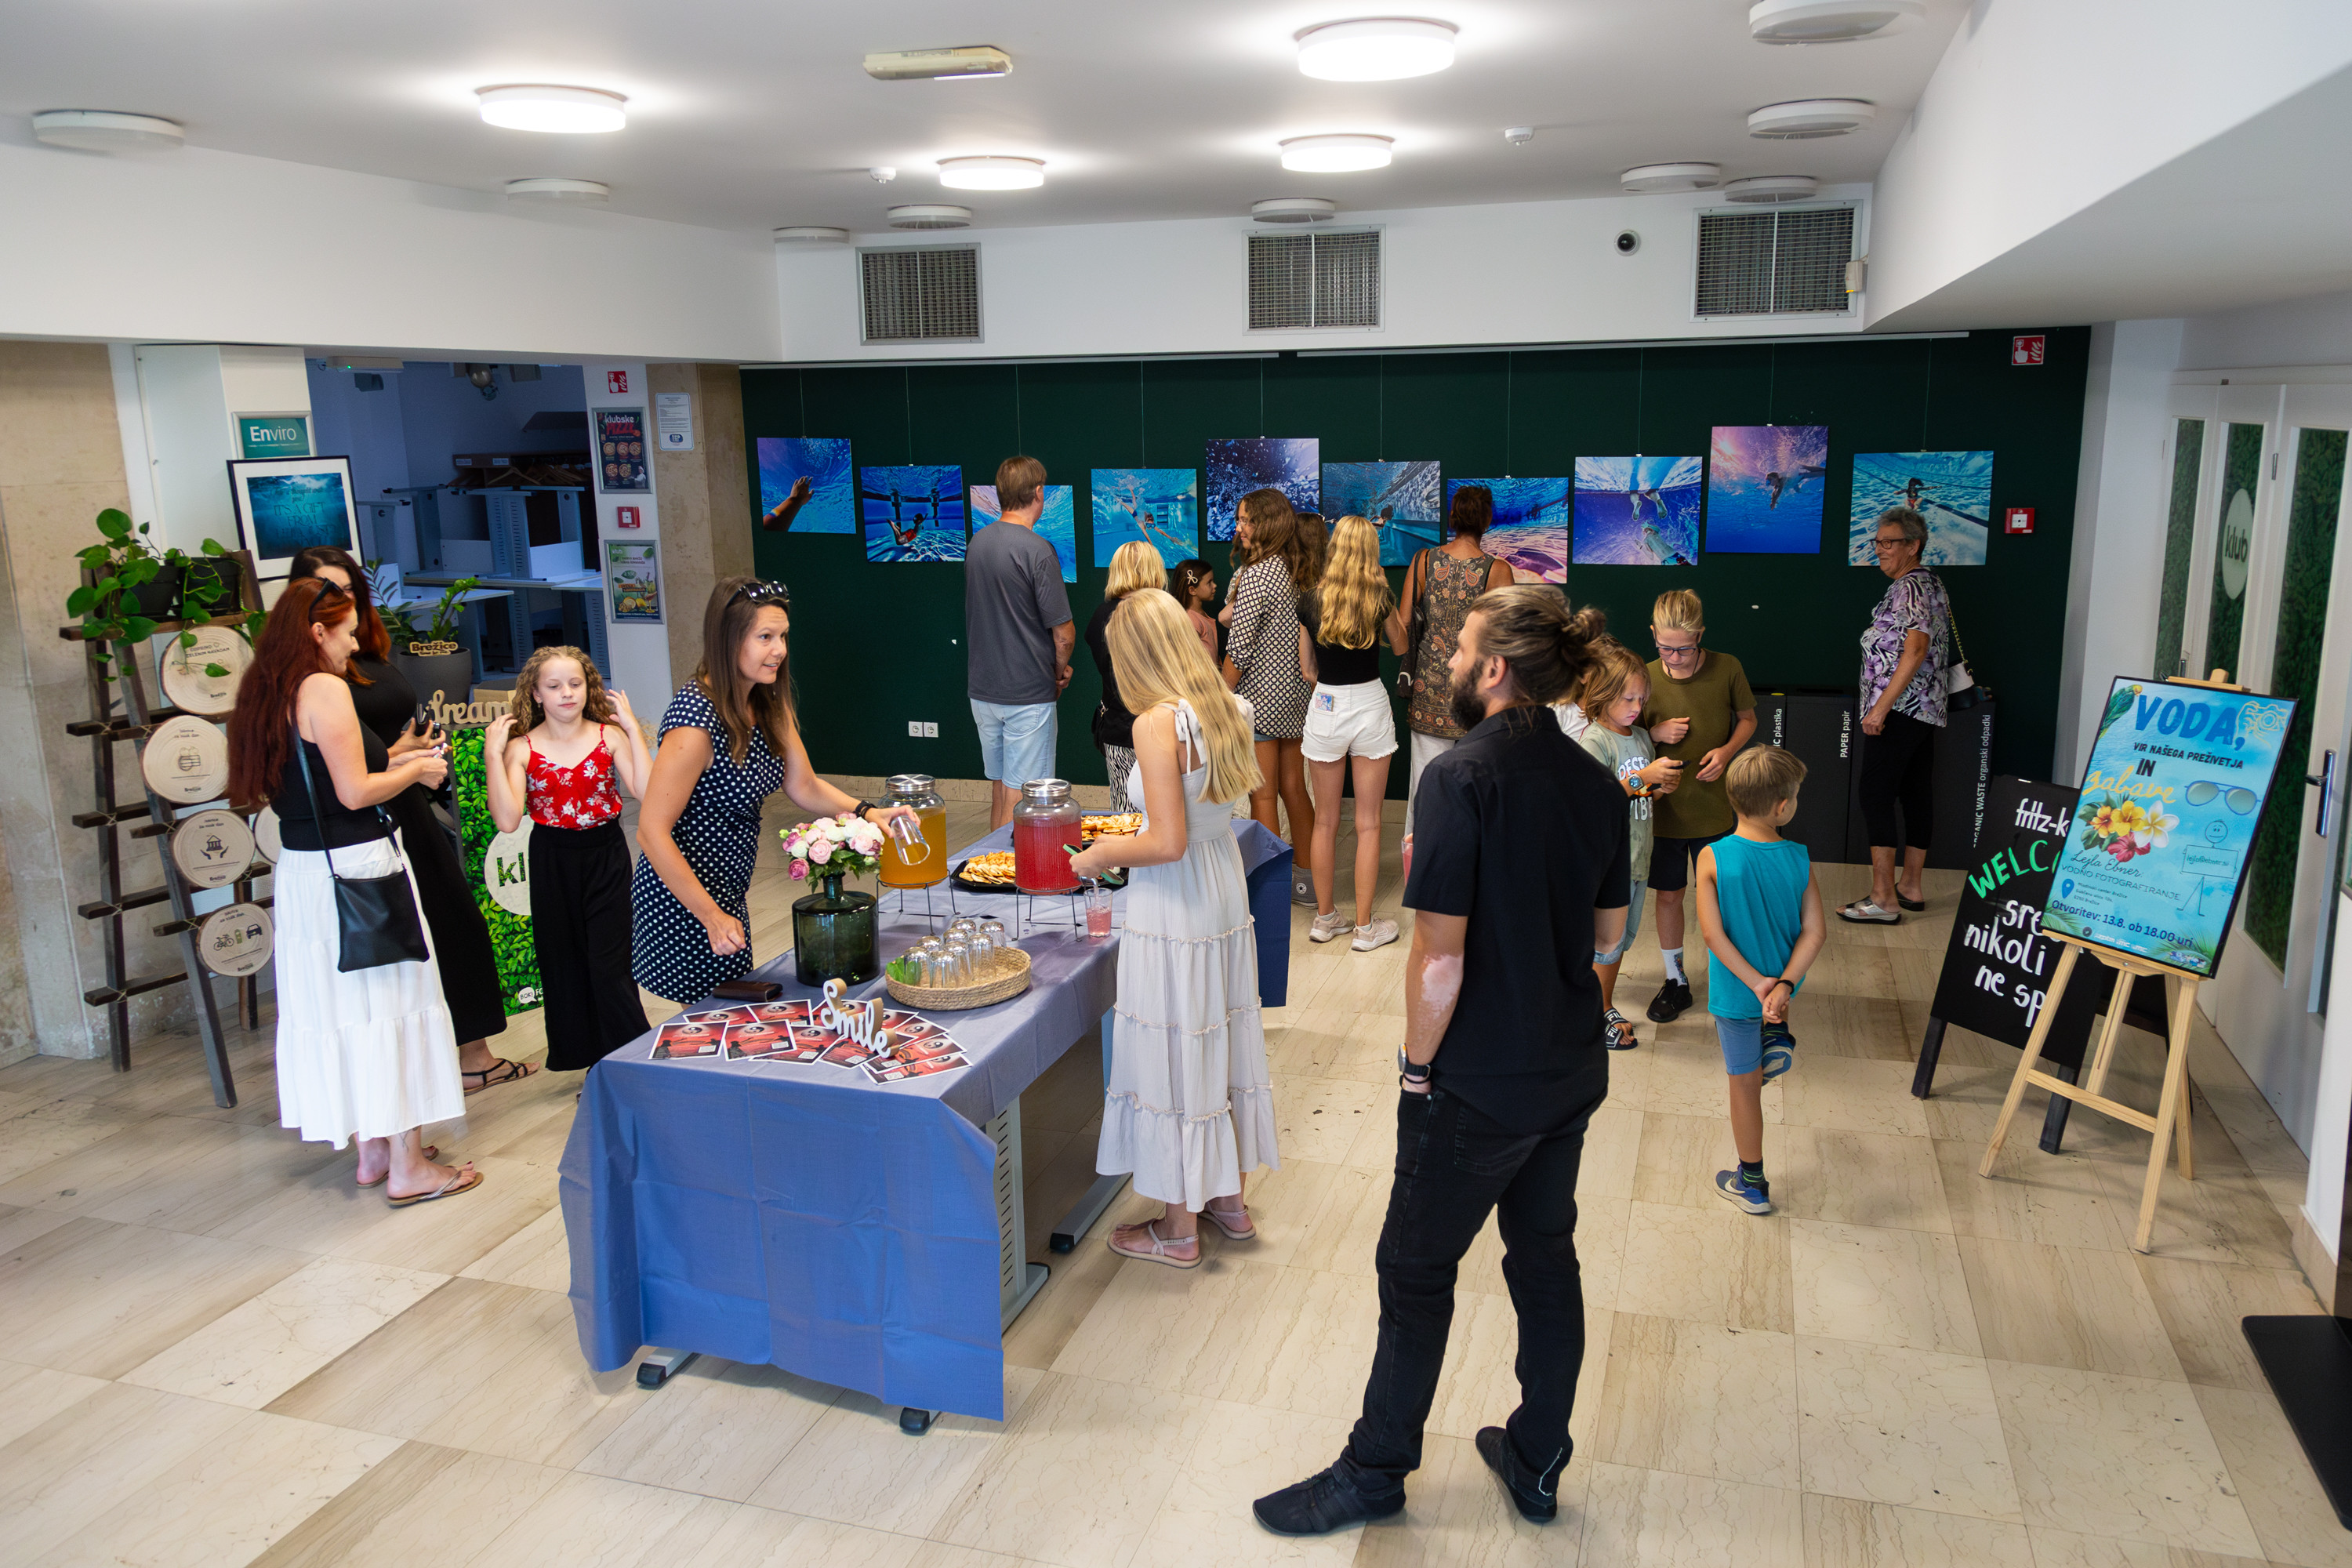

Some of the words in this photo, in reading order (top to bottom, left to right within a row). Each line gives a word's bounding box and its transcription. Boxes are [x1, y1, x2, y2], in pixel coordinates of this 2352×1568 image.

[249, 426, 296, 441] Enviro
[604, 415, 634, 423] klubske
[2224, 524, 2248, 563] klub
[412, 641, 456, 652] Brežice
[1773, 708, 1783, 738] plastika
[1842, 710, 1851, 731] papir
[1980, 714, 1991, 746] odpadki
[2135, 695, 2245, 751] VODA,
[1840, 732, 1849, 758] PAPER
[2133, 742, 2148, 752] VIR
[2149, 744, 2185, 759] NAŠEGA
[2187, 751, 2244, 769] PREŽIVETJA
[1980, 749, 1989, 781] organski
[2136, 757, 2157, 777] IN
[1976, 782, 1986, 811] WASTE
[2082, 765, 2176, 804] zabave
[1973, 811, 1984, 848] RGANIC
[2014, 798, 2071, 837] fritz-k
[496, 851, 526, 887] kl
[1968, 840, 2061, 898] WELC
[2071, 849, 2102, 869] Lejla
[2062, 864, 2093, 878] VODNO
[2095, 873, 2182, 901] FOTOGRAFIRANJE
[2052, 899, 2100, 921] Otvoritev:
[2102, 913, 2125, 928] 13.8.
[2129, 922, 2143, 933] ob
[2144, 925, 2176, 942] 18.00
[2177, 937, 2194, 947] uri
[1964, 914, 2047, 976] nikoli
[520, 991, 533, 1000] BOK!
[1974, 965, 2005, 996] ne
[2013, 983, 2047, 1028] sp
[820, 978, 894, 1058] Smile
[1607, 1011, 1623, 1022] FIL
[1607, 1026, 1618, 1038] FIL
